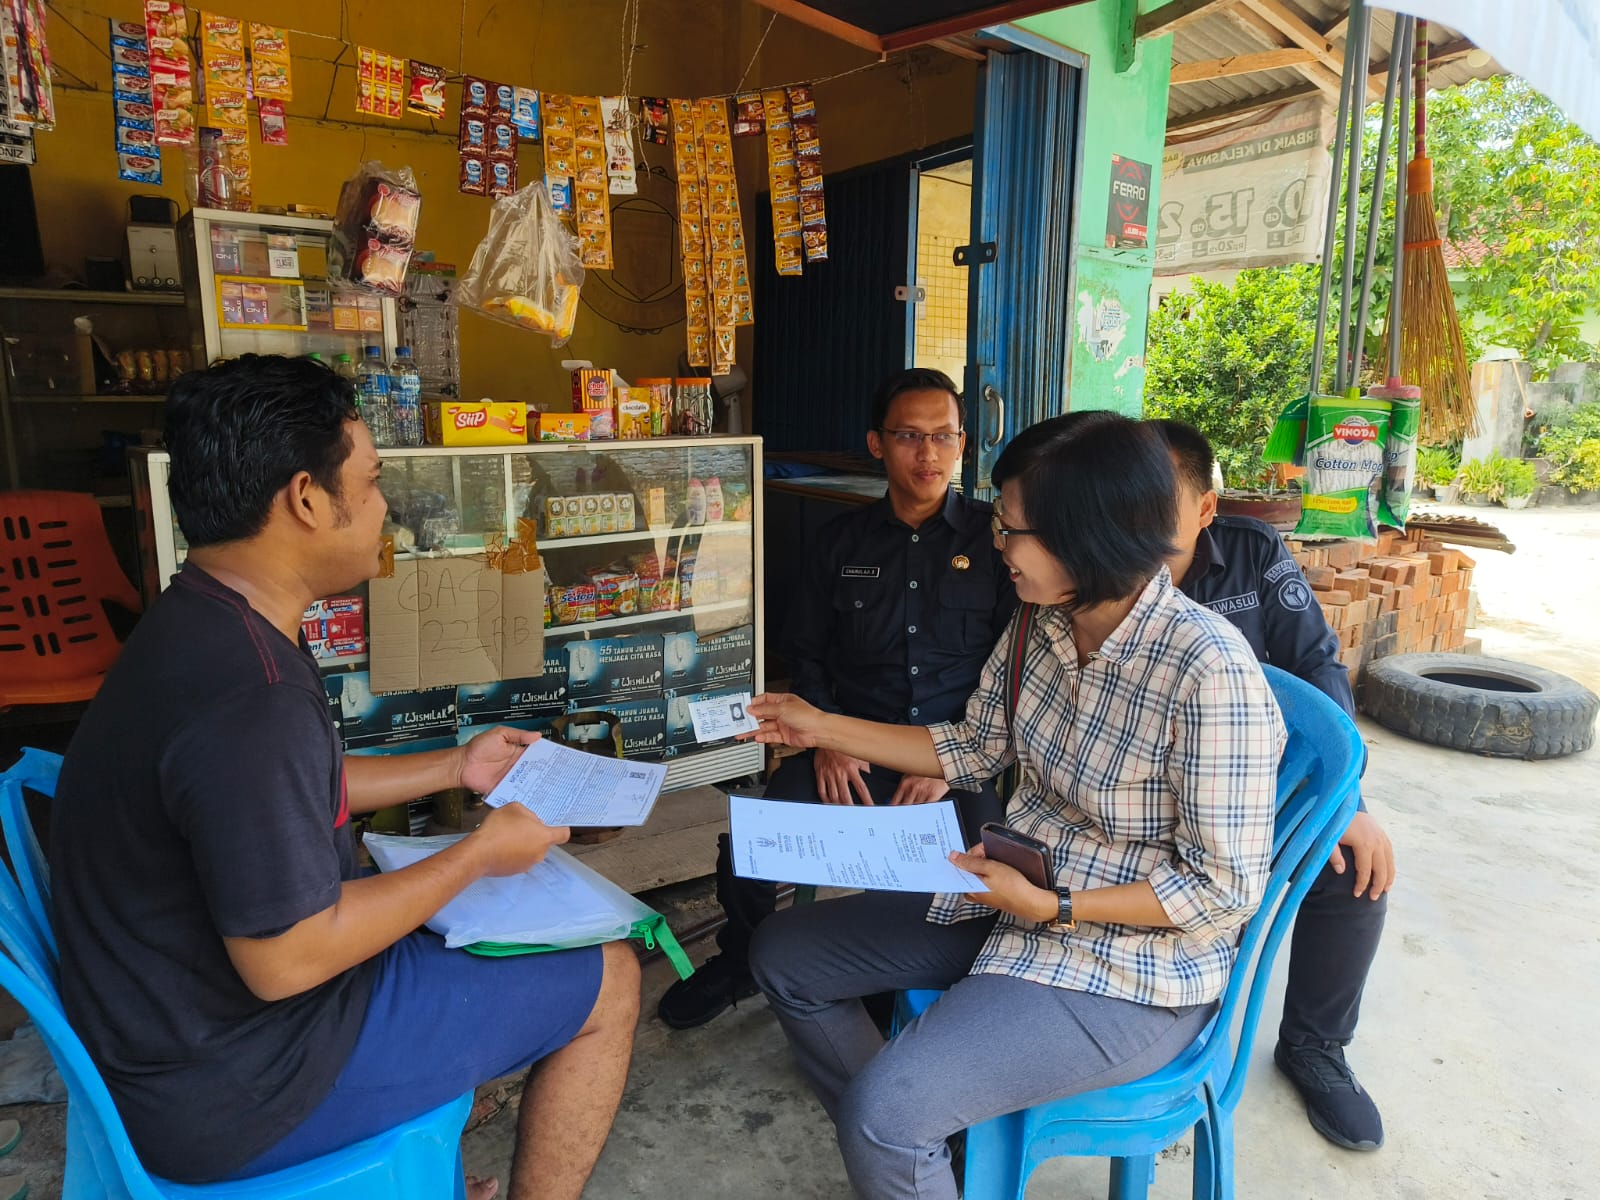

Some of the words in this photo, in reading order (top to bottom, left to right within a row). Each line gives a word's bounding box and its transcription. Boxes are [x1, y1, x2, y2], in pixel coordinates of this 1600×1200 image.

[1112, 179, 1146, 202] FERRO
[1314, 457, 1358, 471] Cotton
[1360, 459, 1383, 473] Mop
[397, 567, 500, 616] GAS
[1206, 594, 1256, 613] AWASLU
[599, 645, 613, 656] 55
[613, 646, 635, 655] TAHUN
[635, 644, 656, 653] JUARA
[645, 651, 662, 659] RASA
